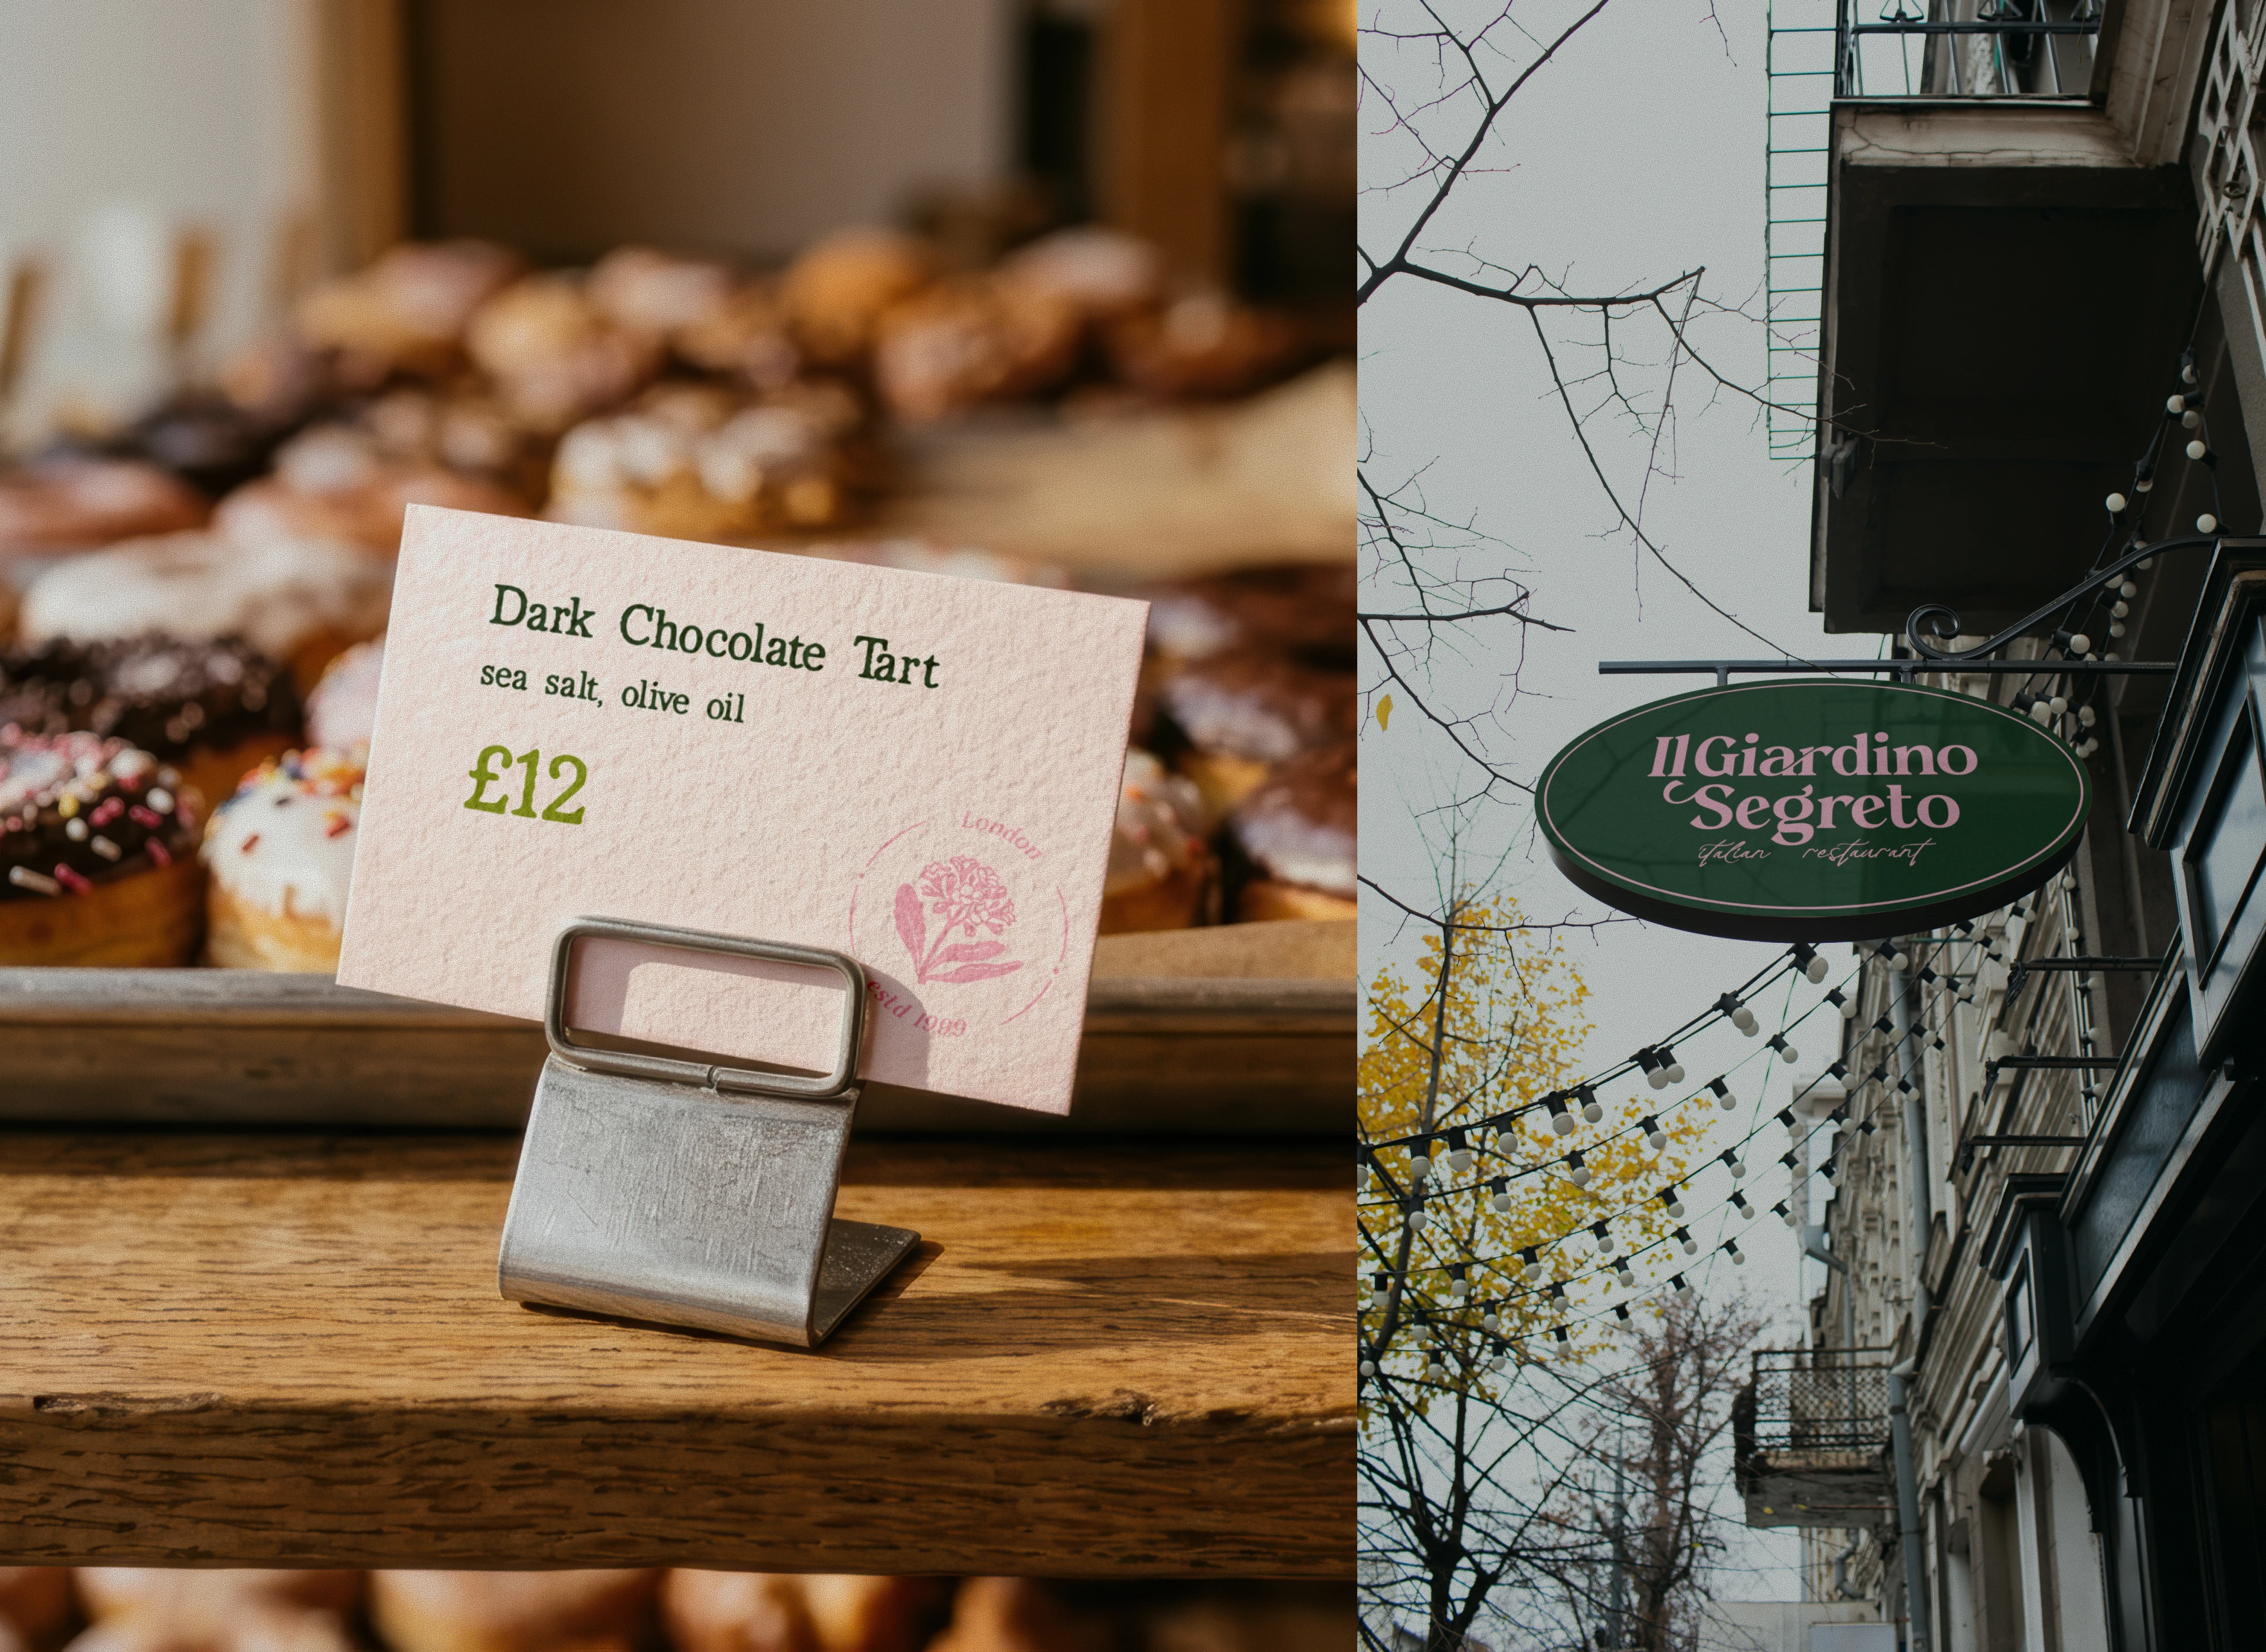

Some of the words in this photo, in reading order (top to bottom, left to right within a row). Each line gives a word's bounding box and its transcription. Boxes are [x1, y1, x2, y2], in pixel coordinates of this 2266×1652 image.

[489, 584, 595, 638] Dark
[620, 603, 826, 672] Chocolate
[853, 635, 941, 689] Tart
[480, 663, 528, 691] sea
[544, 670, 604, 708] salt,
[621, 679, 690, 714] olive
[706, 693, 745, 723] oil
[463, 745, 588, 825] £12
[1662, 779, 1961, 847] Segreto
[961, 810, 1043, 861] London
[1698, 839, 1771, 868] italian
[1802, 837, 1937, 867] restaurant
